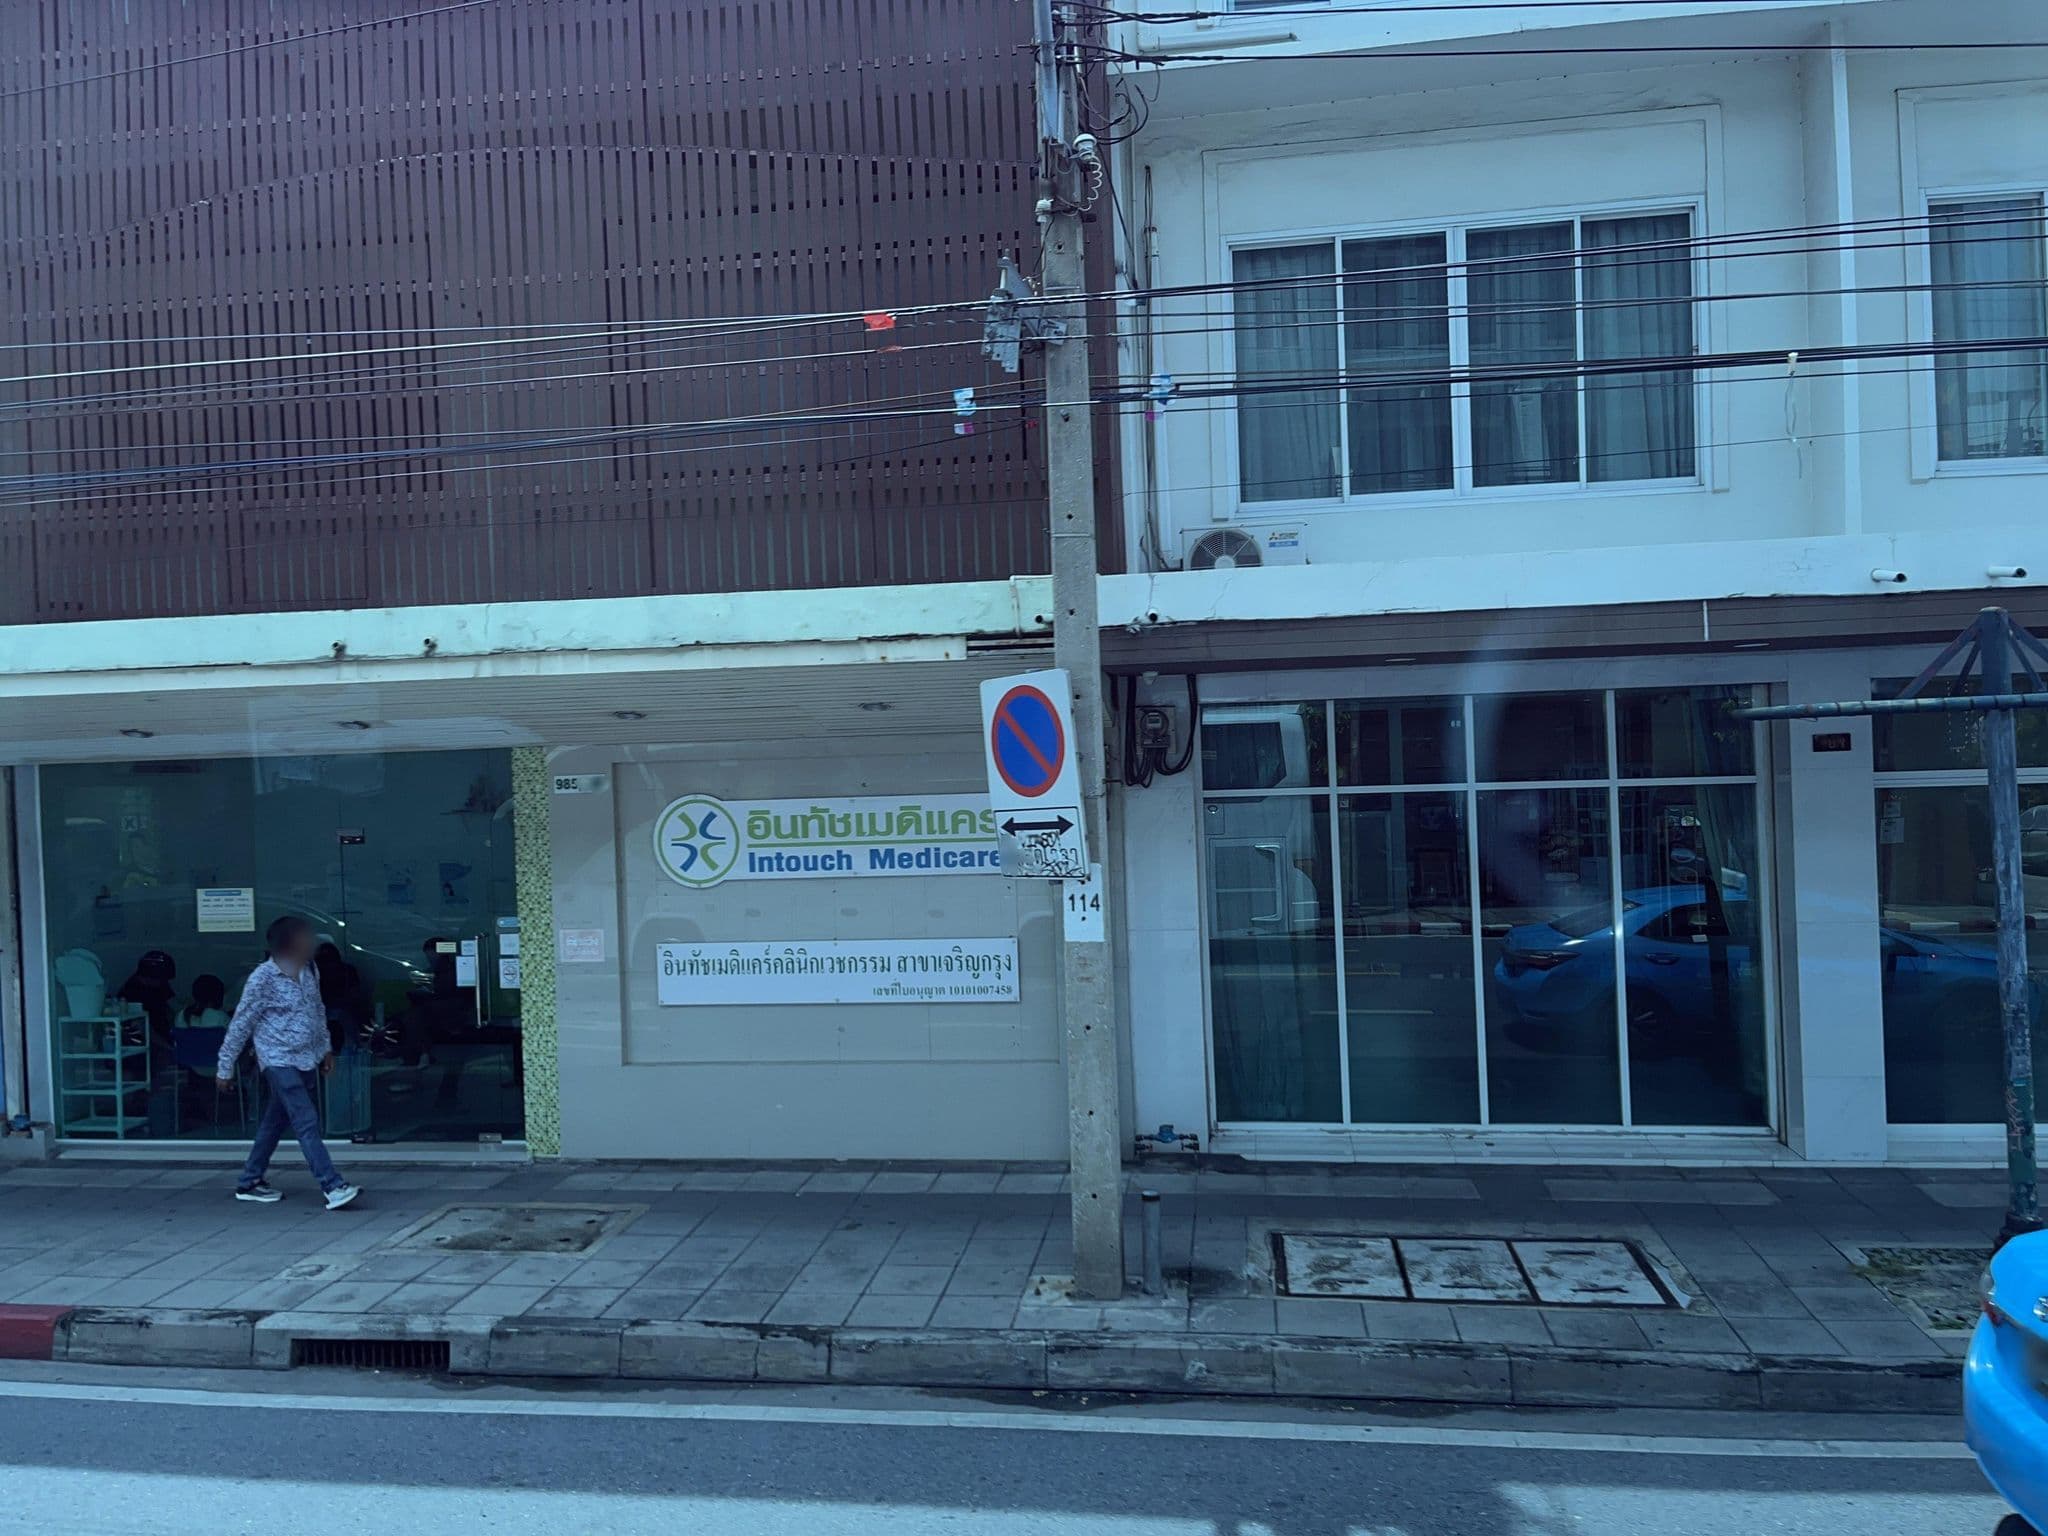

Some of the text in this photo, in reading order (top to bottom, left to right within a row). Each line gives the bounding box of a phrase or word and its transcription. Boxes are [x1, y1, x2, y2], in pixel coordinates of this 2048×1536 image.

[749, 849, 852, 873] Intouch
[869, 847, 1001, 870] Medicare
[1068, 893, 1100, 912] 114
[663, 945, 1012, 980] อินทัชเมดิแคร์คลินิกเวชกรรม สาขาเจริญกรุง
